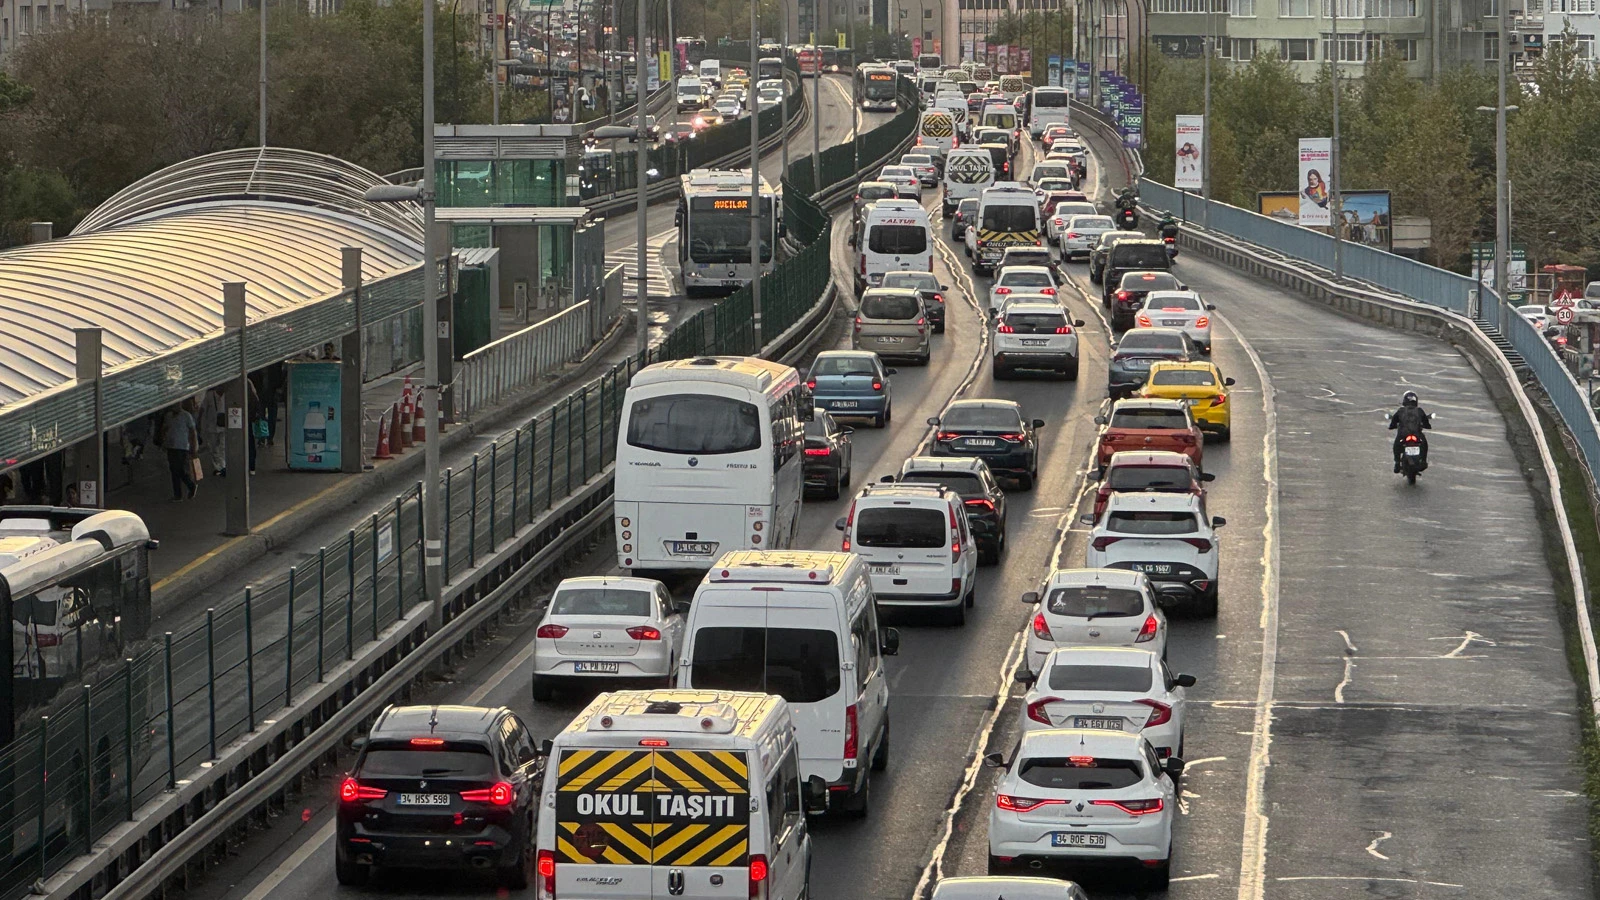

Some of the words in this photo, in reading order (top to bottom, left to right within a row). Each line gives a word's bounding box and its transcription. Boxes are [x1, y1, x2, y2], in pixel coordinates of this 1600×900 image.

[949, 164, 968, 172] OKUL
[714, 200, 748, 209] AVCILAR
[1560, 311, 1571, 319] 30
[402, 794, 411, 804] 34
[415, 794, 431, 804] HSS
[433, 794, 448, 804] 598
[575, 792, 644, 817] OKUL
[656, 794, 735, 820] TAŞITI
[1056, 834, 1066, 844] 34
